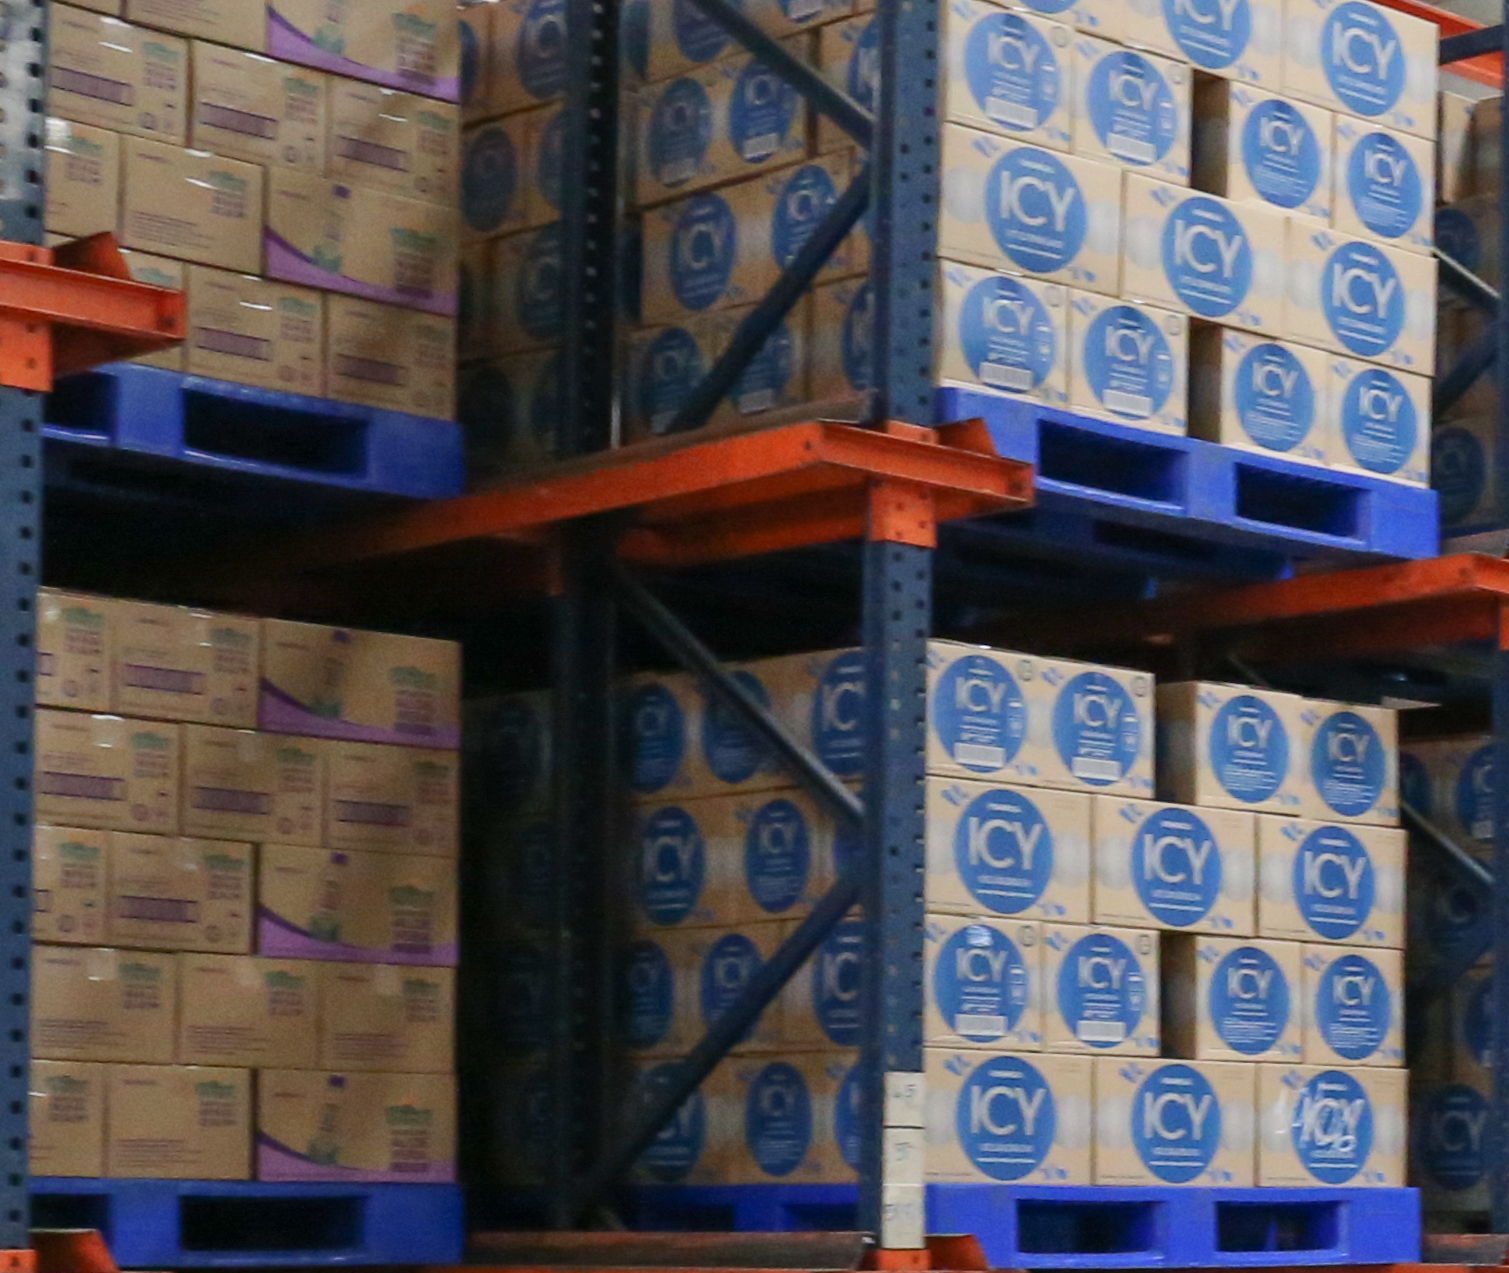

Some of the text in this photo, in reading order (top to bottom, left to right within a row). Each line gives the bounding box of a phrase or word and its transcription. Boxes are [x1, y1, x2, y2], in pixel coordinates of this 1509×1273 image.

[987, 33, 1042, 72] ICY
[1332, 26, 1399, 78] ICY
[1108, 72, 1157, 109] ICY
[1260, 118, 1303, 155] ICY
[1364, 151, 1406, 185] ICY
[1001, 175, 1073, 231] ICY
[1174, 219, 1244, 277] ICY
[1332, 267, 1399, 317] ICY
[983, 298, 1034, 334] ICY
[1105, 327, 1155, 363] ICY
[1251, 362, 1297, 396] ICY
[1359, 387, 1401, 421] ICY
[955, 678, 1006, 712] ICY
[1072, 694, 1122, 727] ICY
[1228, 716, 1270, 748] ICY
[1328, 731, 1368, 762] ICY
[968, 816, 1042, 869] ICY
[1144, 834, 1211, 884] ICY
[1304, 852, 1365, 898] ICY
[956, 945, 1005, 982] ICY
[1078, 956, 1125, 989] ICY
[1228, 968, 1271, 999] ICY
[1332, 975, 1375, 1006] ICY
[971, 1082, 1045, 1136] ICY
[1144, 1092, 1212, 1140] ICY
